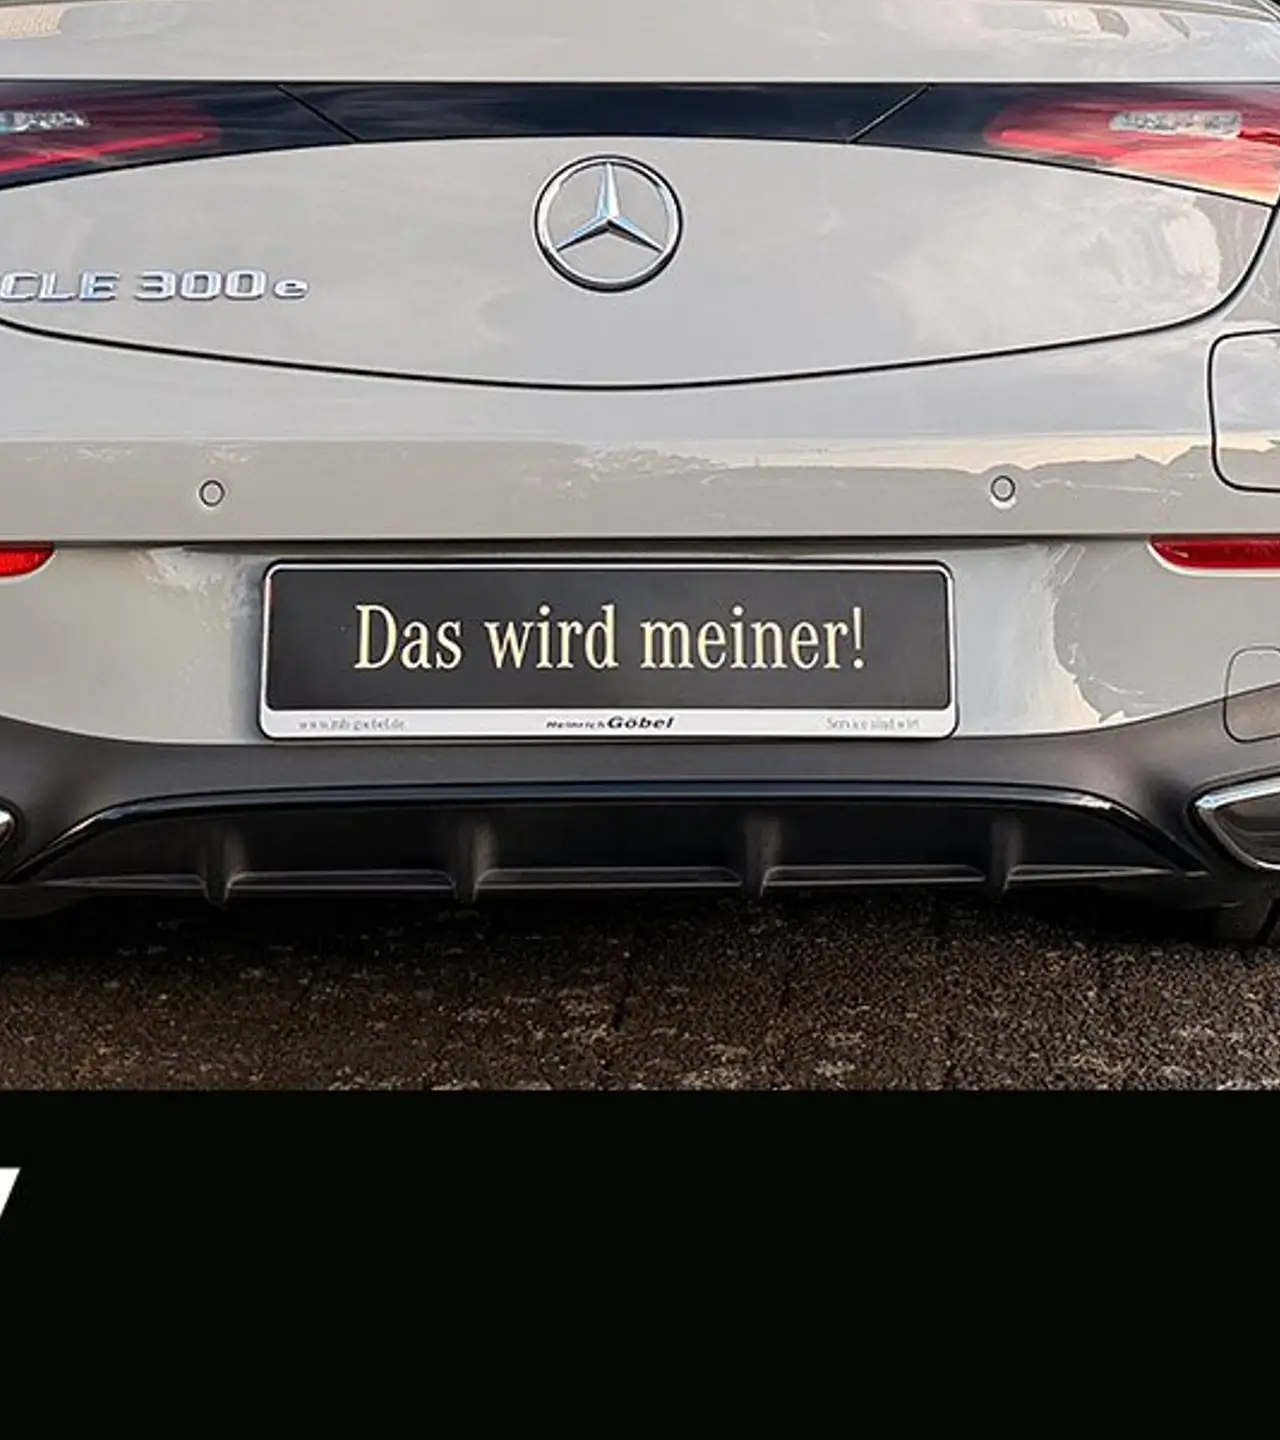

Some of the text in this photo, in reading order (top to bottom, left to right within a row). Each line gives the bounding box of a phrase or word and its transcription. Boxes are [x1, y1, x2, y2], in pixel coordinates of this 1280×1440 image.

[353, 603, 866, 670] Das wird meiner!
[606, 715, 676, 730] Göbel
